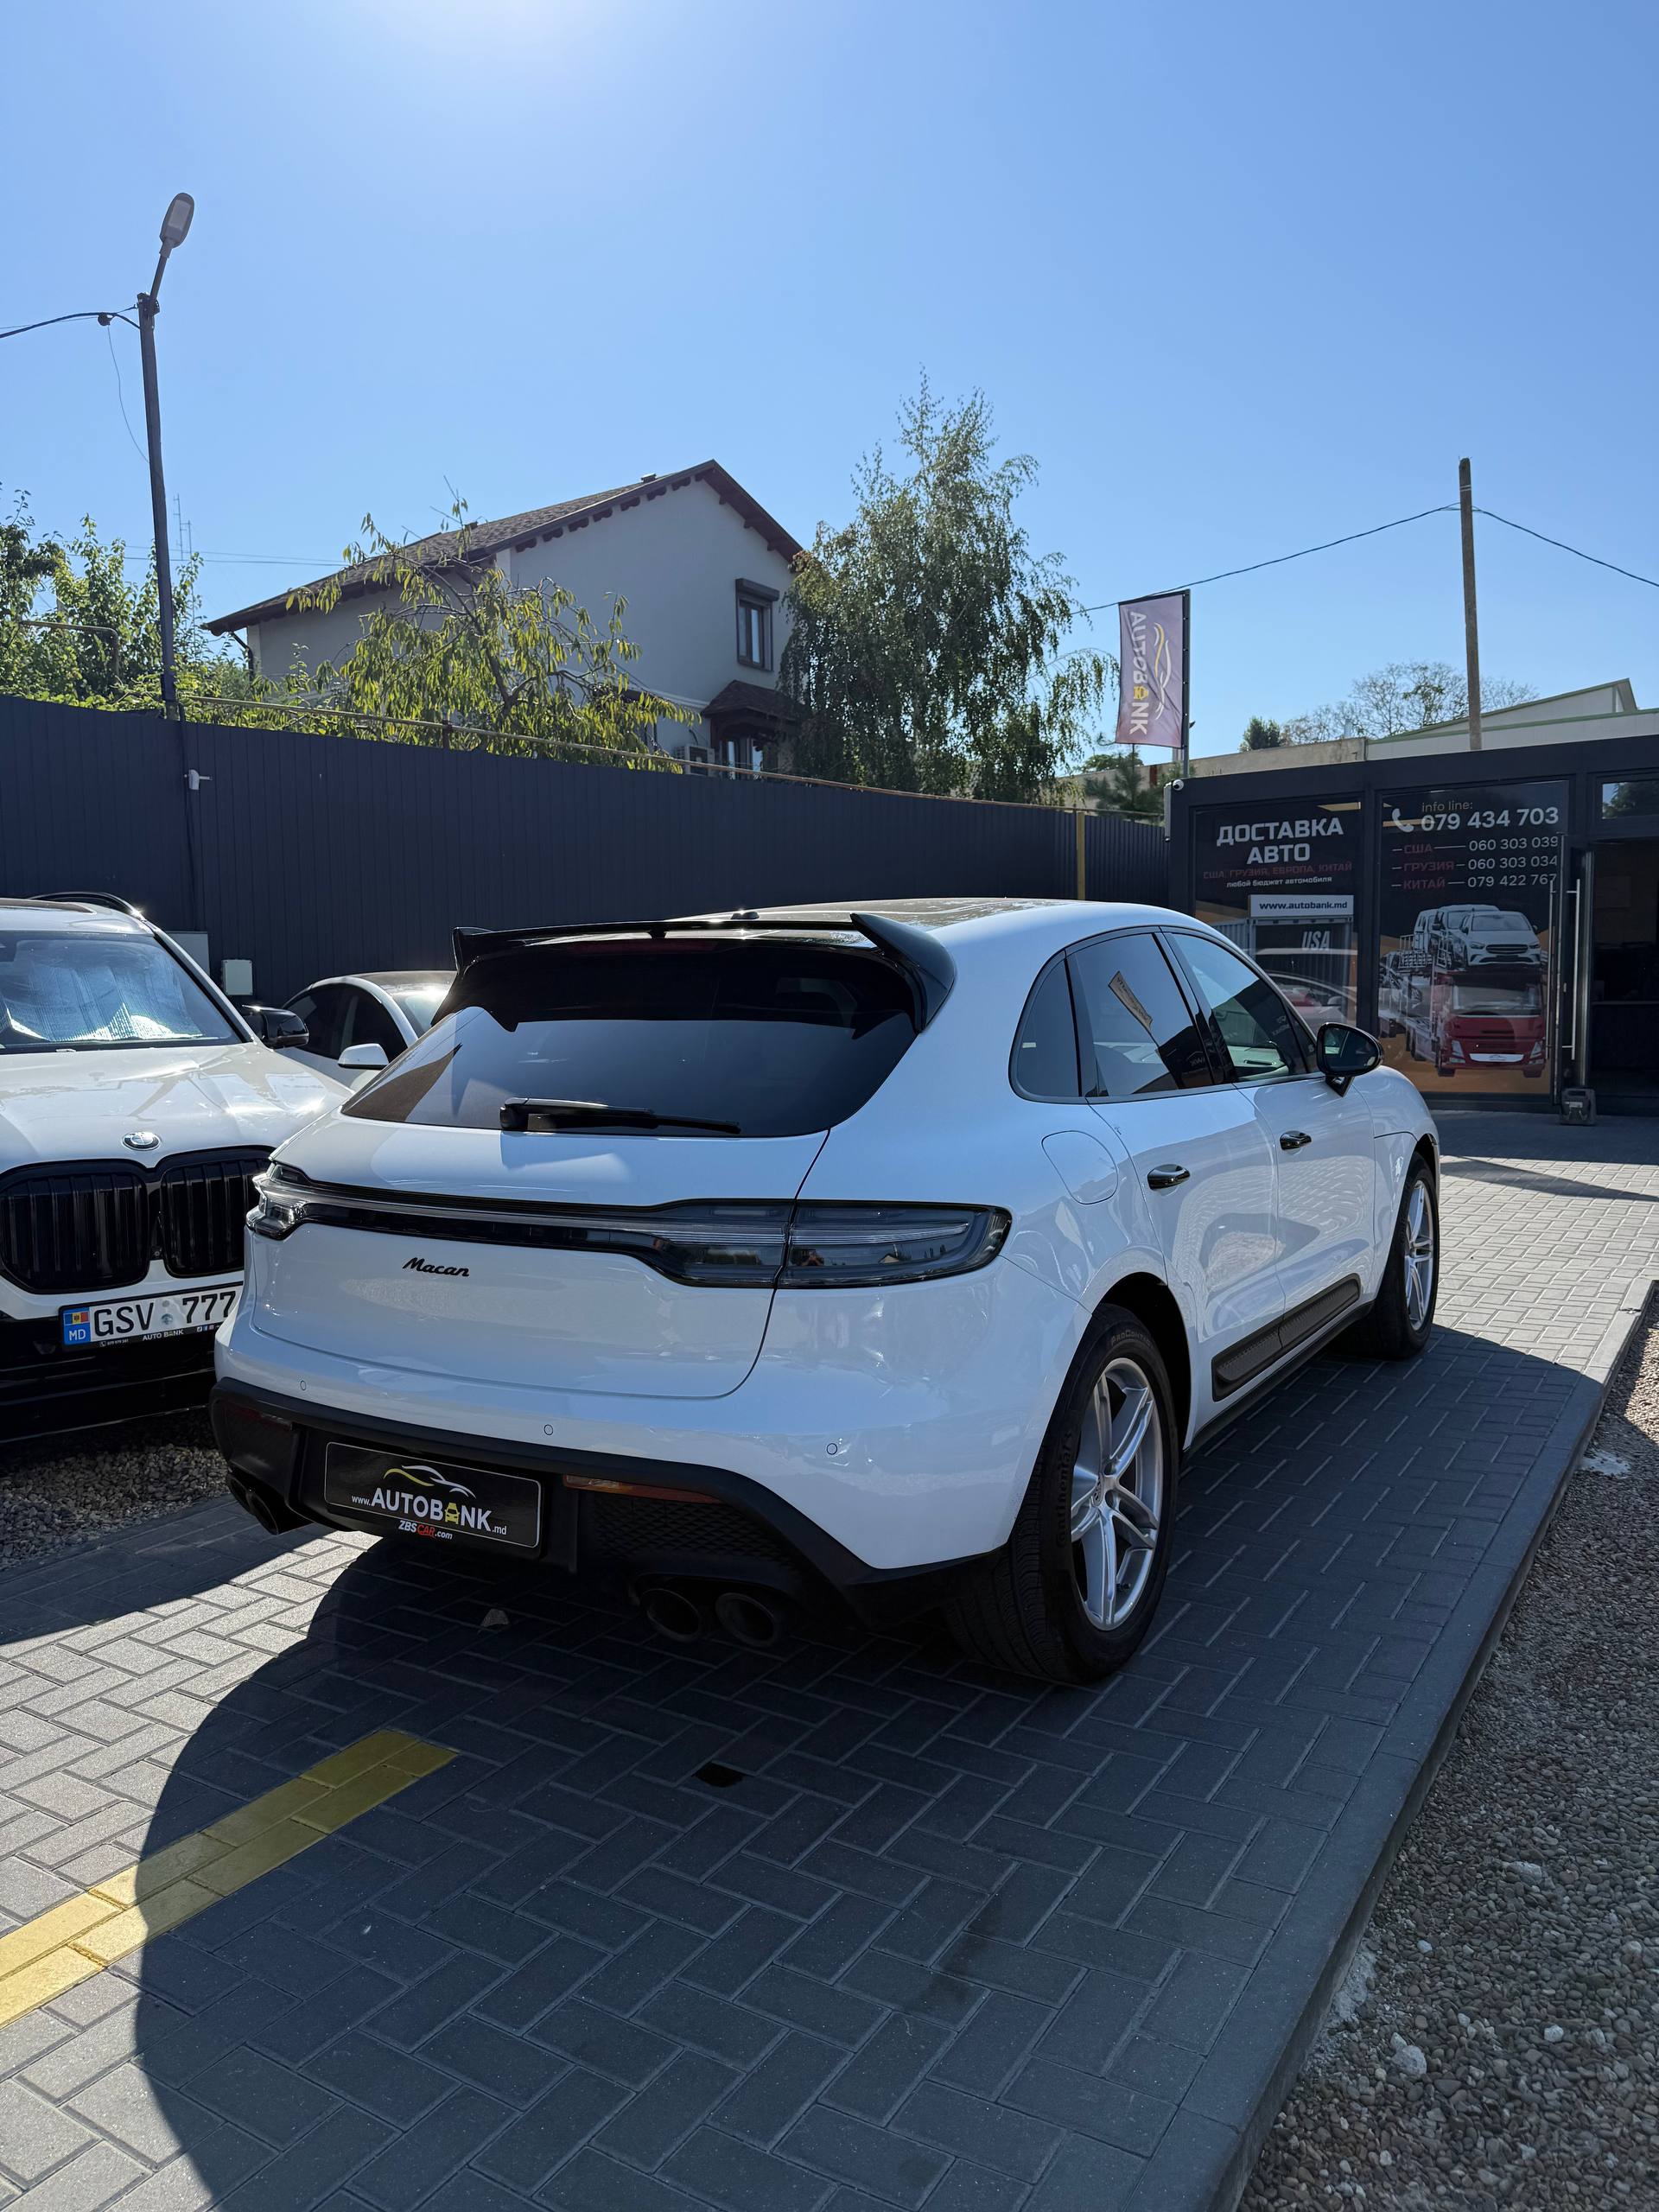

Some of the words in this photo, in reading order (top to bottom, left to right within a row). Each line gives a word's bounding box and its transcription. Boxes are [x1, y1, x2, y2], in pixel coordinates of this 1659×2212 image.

[1421, 801, 1445, 812] info
[1448, 800, 1473, 810] line:
[1421, 813, 1460, 831] 079
[1467, 810, 1510, 829] 434
[1516, 806, 1559, 826] 703
[1216, 817, 1344, 847] ДОСТАВКА
[1247, 843, 1311, 864] АВТО
[1404, 844, 1433, 855] США
[1469, 840, 1496, 851] 060
[1500, 838, 1528, 849] 303
[1531, 836, 1558, 848] 039
[1403, 861, 1454, 872] ГРУЗИЯ
[1468, 858, 1496, 870] 060
[1499, 857, 1526, 868] 303
[1530, 855, 1557, 867] 034
[1226, 880, 1251, 888] любой
[1253, 878, 1283, 887] бюджет
[1285, 875, 1332, 885] автомобиля
[1403, 876, 1446, 889] КИТАЙ
[1468, 876, 1494, 887] 079
[1499, 874, 1526, 886] 422
[1531, 874, 1557, 885] 767
[1259, 901, 1348, 910] www.autobank.md
[1301, 931, 1332, 951] USA
[402, 1257, 470, 1277] Macan
[93, 1302, 154, 1337] GSV
[182, 1290, 237, 1324] 777
[68, 1329, 86, 1341] MD
[142, 1332, 162, 1342] AUTO
